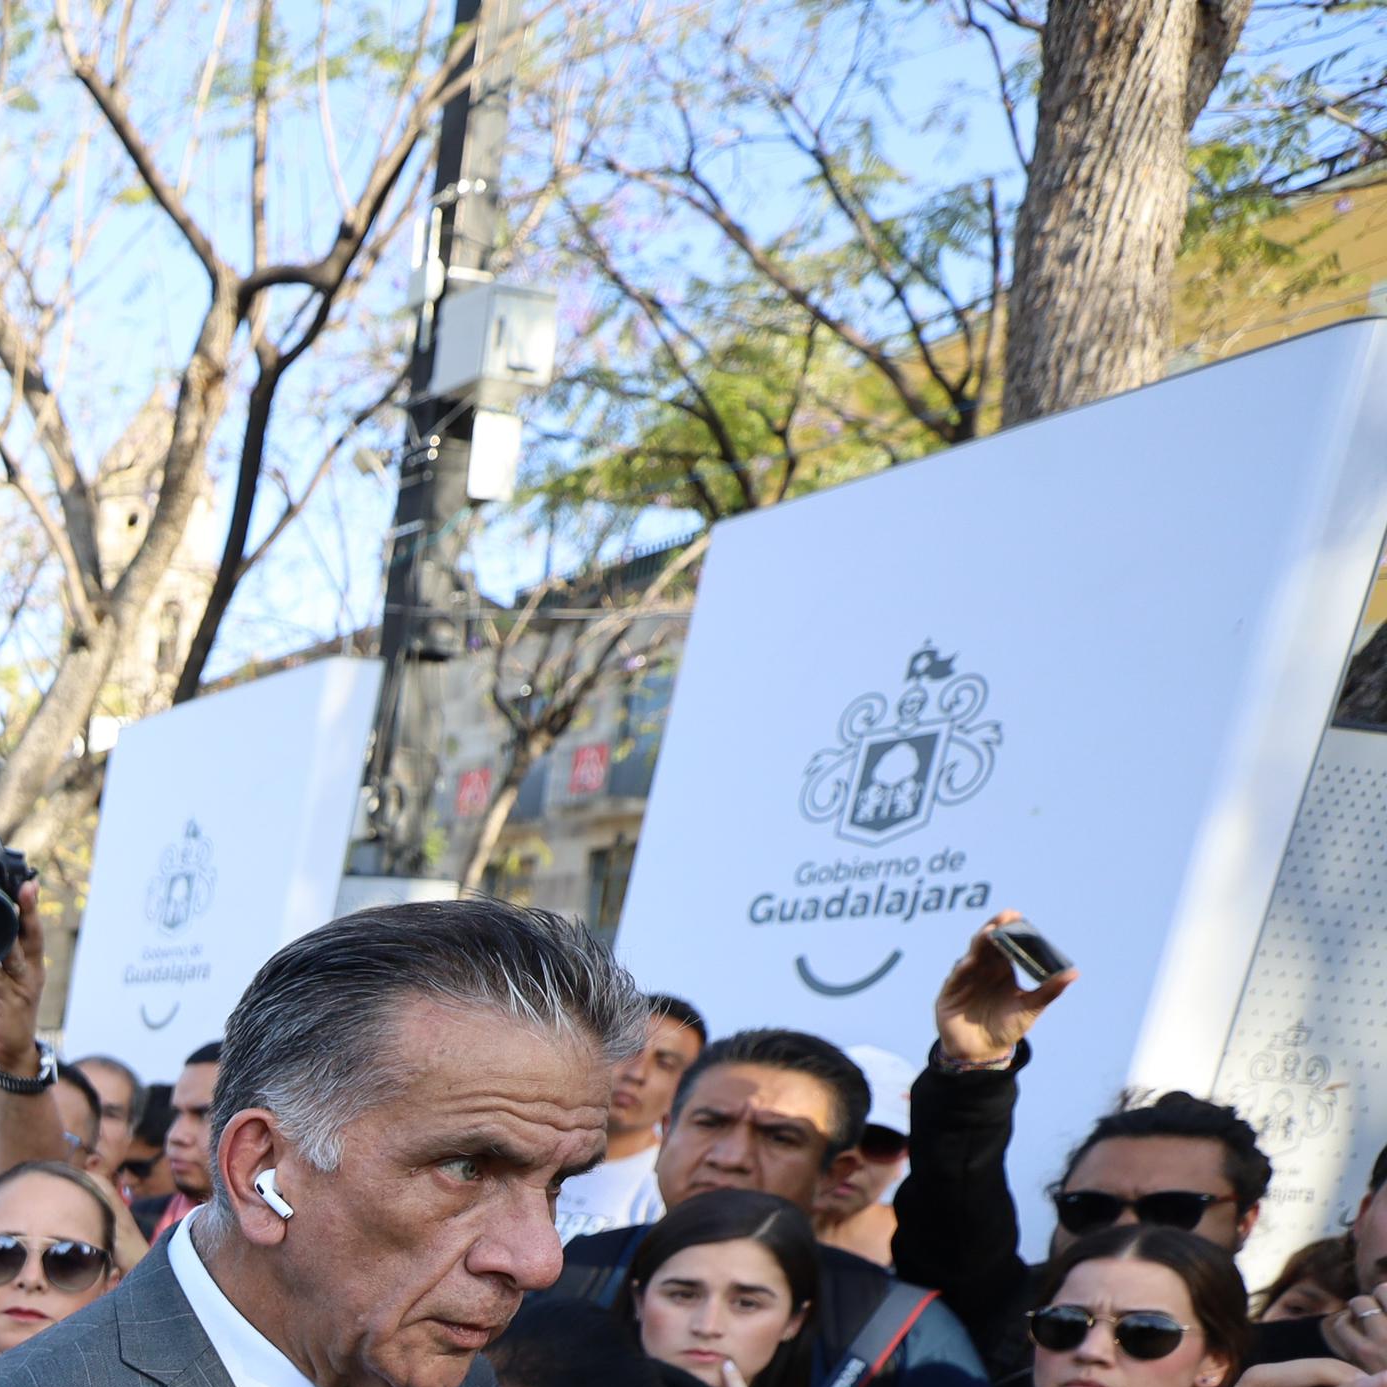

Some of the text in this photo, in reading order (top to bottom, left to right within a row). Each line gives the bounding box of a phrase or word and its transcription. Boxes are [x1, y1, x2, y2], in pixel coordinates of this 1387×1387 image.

[794, 847, 966, 887] Gobierno de
[748, 877, 992, 925] Guadalajara
[141, 943, 187, 962] Gobierno
[123, 962, 212, 986] Guadalajara
